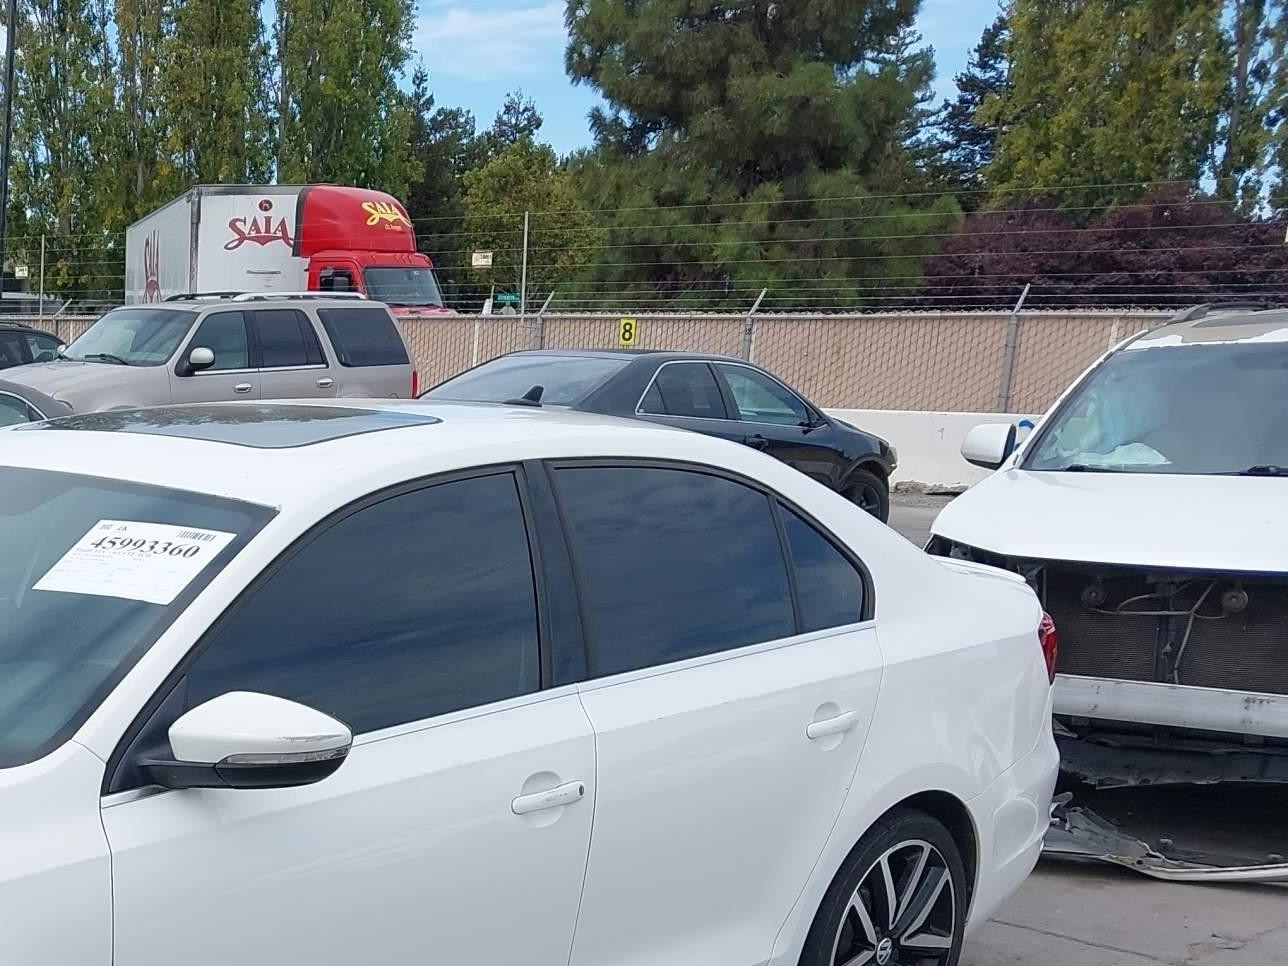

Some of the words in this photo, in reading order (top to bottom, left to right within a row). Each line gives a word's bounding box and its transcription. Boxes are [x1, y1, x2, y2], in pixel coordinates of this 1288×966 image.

[361, 201, 412, 228] SAIA
[223, 215, 294, 251] SAIA
[622, 322, 633, 341] 8
[91, 536, 201, 559] 45993360
